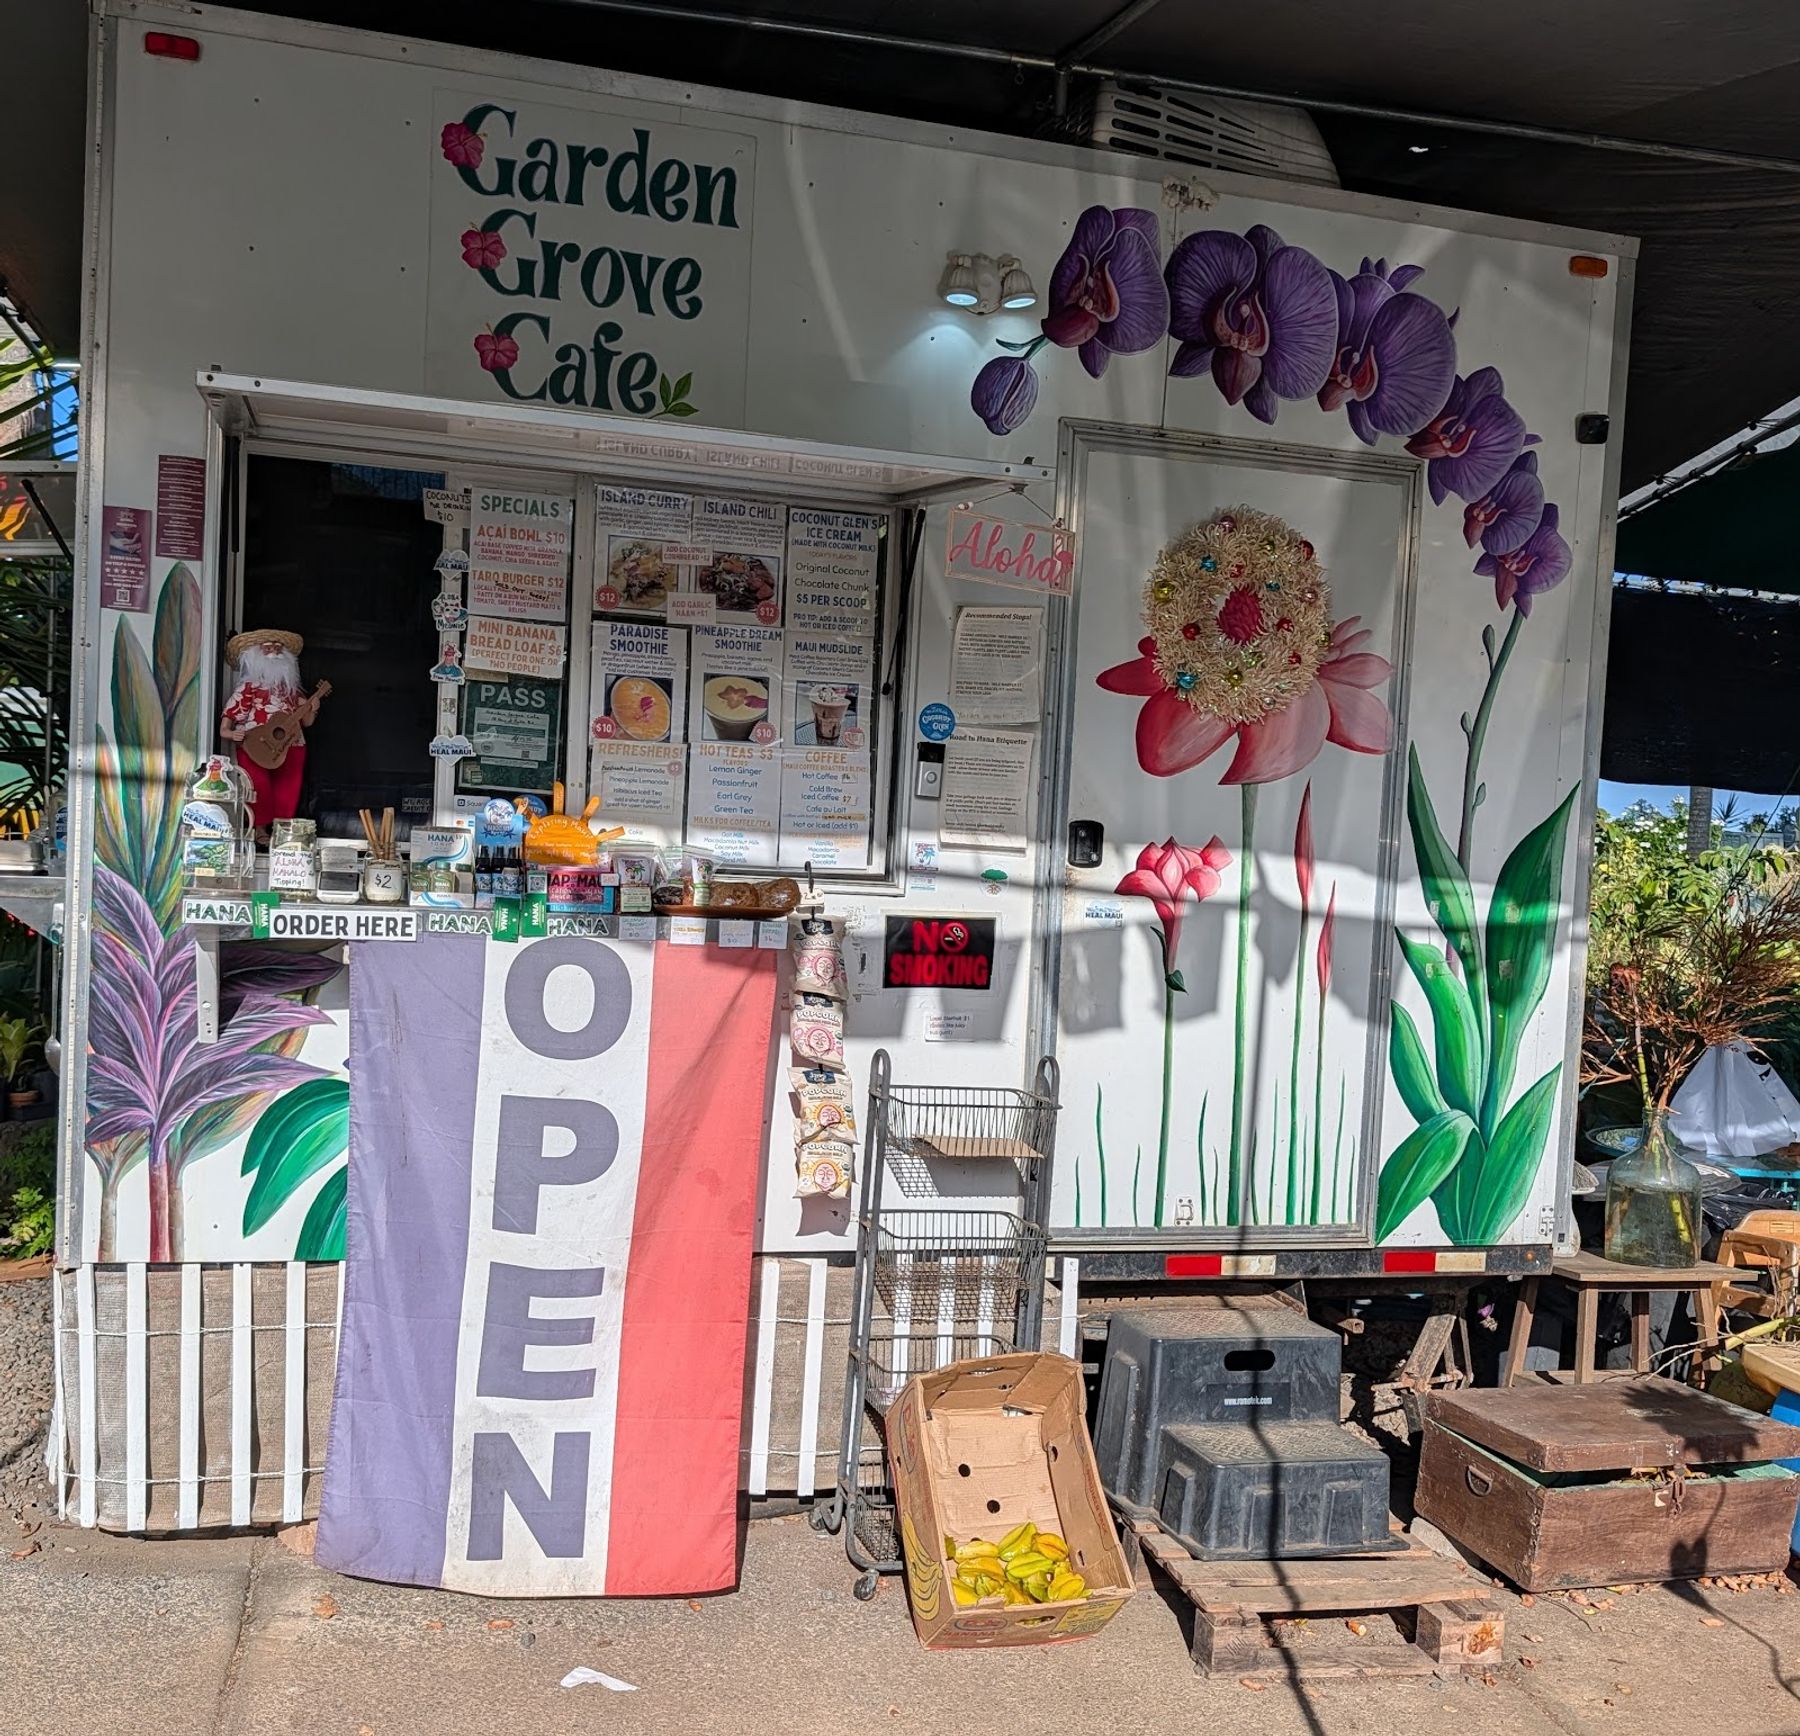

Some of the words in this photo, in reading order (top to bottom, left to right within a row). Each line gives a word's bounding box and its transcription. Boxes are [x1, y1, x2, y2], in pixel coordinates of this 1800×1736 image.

[446, 103, 739, 229] Garden
[465, 208, 704, 320] Grove
[483, 312, 659, 415] Cafe
[480, 495, 560, 518] SPECIALS
[601, 489, 646, 506] ISLAND
[648, 494, 689, 510] CURRY
[703, 500, 746, 517] ISLAND
[749, 506, 777, 520] CHILI
[791, 511, 840, 527] COCONUT
[842, 516, 877, 530] GLEN'S
[510, 526, 542, 543] BOWL
[545, 531, 566, 545] $10
[806, 526, 824, 540] ICE
[825, 529, 862, 544] CREAM
[950, 520, 1057, 583] Aloha
[795, 562, 831, 574] Original
[832, 563, 870, 578] Coconut
[472, 570, 500, 582] TARO
[502, 572, 545, 587] BURGER
[547, 577, 564, 589] $12
[794, 578, 840, 590] Chocolate
[841, 581, 870, 592] Chunk
[599, 592, 616, 603] $12
[671, 600, 686, 608] ADD
[796, 592, 810, 606] $5
[810, 594, 830, 608] PER
[831, 596, 867, 610] SCOOP
[759, 607, 775, 618] $12
[965, 612, 1012, 620] Recommended
[1012, 612, 1032, 622] Stops!
[478, 620, 503, 636] MINI
[506, 624, 557, 642] BANANA
[610, 624, 668, 642] PARADISE
[695, 626, 746, 640] PINEAPPLE
[749, 630, 782, 642] DREAM
[470, 634, 512, 651] BREAD
[514, 640, 546, 655] LOAF
[548, 644, 562, 656] $6
[609, 639, 668, 655] SMOOTHIE
[714, 638, 762, 652] SMOOTHIE
[795, 641, 817, 652] MAUI
[819, 643, 864, 656] MUDSLIDE
[511, 653, 528, 663] FOR
[529, 655, 546, 665] ONE
[480, 683, 546, 709] PASS
[595, 723, 612, 733] $10
[756, 727, 772, 738] $10
[976, 735, 994, 744] Hana
[996, 737, 1028, 747] Etiquette
[431, 748, 450, 756] HEAL
[451, 748, 472, 756] MAUI
[599, 742, 683, 760] REFRESHERS!
[699, 744, 723, 757] HOT
[725, 746, 754, 760] TEAS
[759, 749, 774, 763] $3
[805, 751, 848, 764] COFFEE
[634, 766, 666, 774] Lemonade
[708, 764, 735, 774] Lemon
[736, 766, 763, 777] Ginger
[815, 773, 839, 781] Coffee
[609, 776, 638, 785] Pineapple
[639, 777, 670, 786] Lemonade
[712, 778, 758, 790] Passionfruit
[652, 789, 662, 797] Tea
[716, 791, 732, 800] Earl
[734, 792, 753, 803] Grey
[808, 785, 824, 794] Cold
[825, 786, 842, 794] Brew
[466, 800, 483, 808] Squar
[801, 793, 816, 801] Iced
[816, 794, 840, 802] Coffee
[183, 809, 203, 824] HEAL
[714, 804, 737, 815] Green
[738, 805, 754, 815] Tea
[805, 804, 822, 814] Cafe
[833, 805, 847, 814] Lait
[530, 818, 568, 840] Exploring
[815, 821, 830, 830] Iced
[831, 822, 848, 831] (add
[849, 822, 859, 831] $1)
[427, 833, 455, 844] HANA
[274, 877, 306, 889] Tipping!
[374, 873, 393, 890] $2
[185, 903, 252, 922] HANA
[260, 903, 268, 928] HANA
[499, 908, 509, 931] HANA
[531, 903, 540, 928] HANA
[1085, 911, 1104, 920] HEAL
[1104, 911, 1124, 920] MAUI
[273, 914, 350, 938] ORDER
[356, 916, 414, 939] HERE
[430, 912, 493, 934] HANA
[547, 916, 609, 938] HANA
[912, 919, 970, 953] NO
[800, 939, 841, 950] POPCORN
[889, 954, 989, 986] SMOKING
[797, 1010, 841, 1024] POPCORN
[802, 1087, 846, 1098] POPCORN
[802, 1142, 849, 1154] POPCORN
[465, 936, 634, 1562] OPEN
